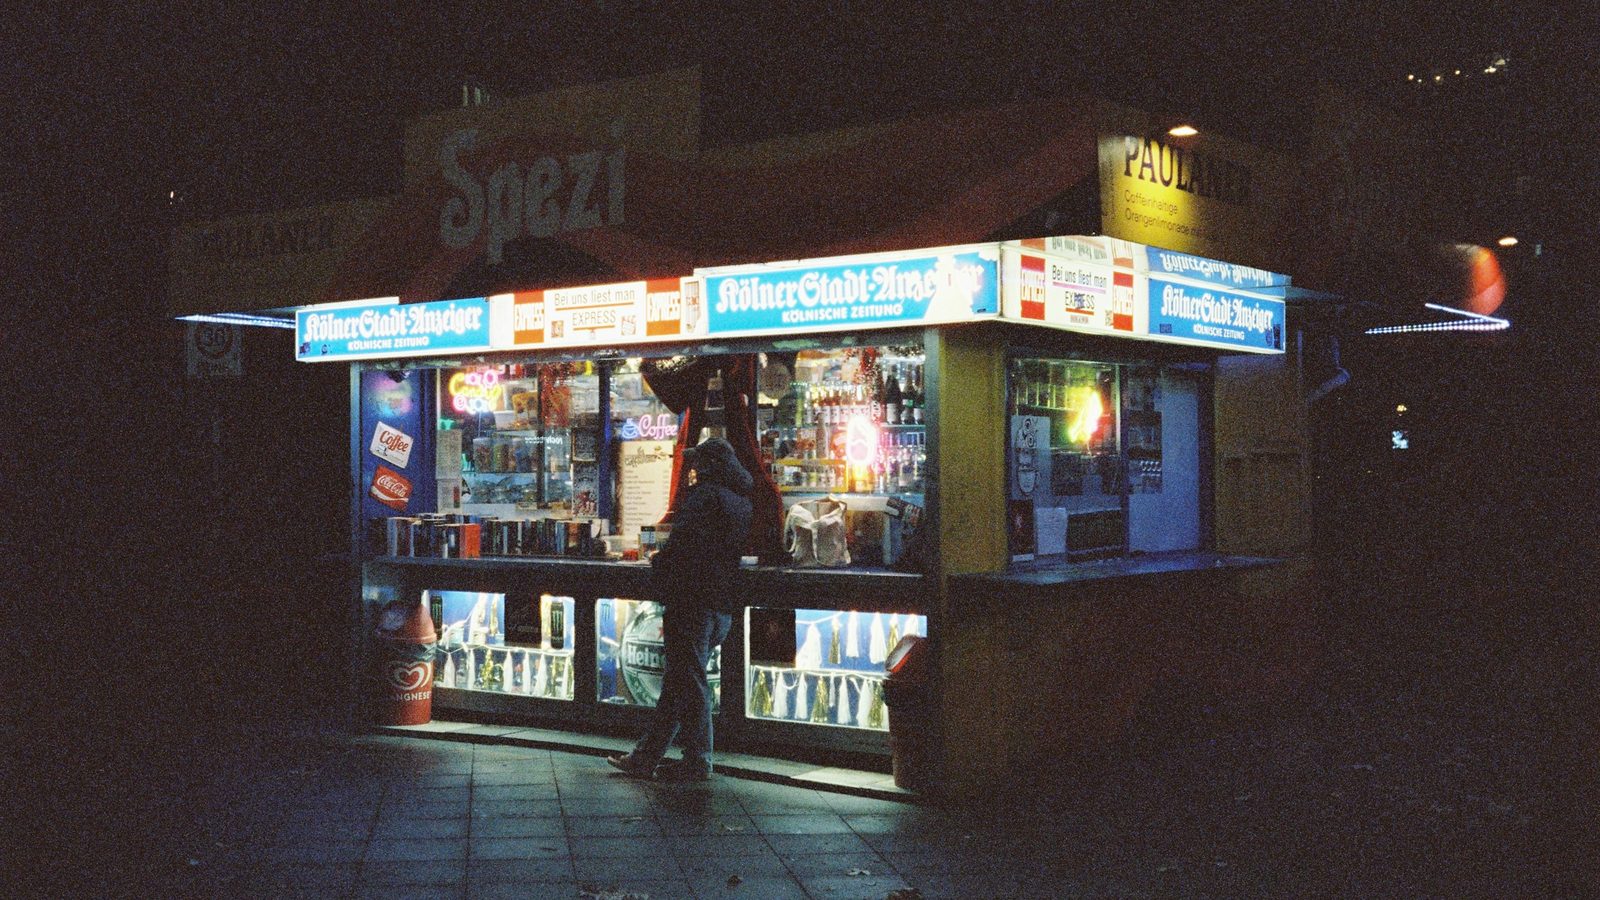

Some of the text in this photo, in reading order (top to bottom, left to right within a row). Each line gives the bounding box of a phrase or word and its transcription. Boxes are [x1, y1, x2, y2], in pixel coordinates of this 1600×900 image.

[439, 118, 627, 265] Spezi
[1052, 264, 1107, 288] Bei uns liest man
[554, 289, 635, 306] Bei uns liest man
[572, 309, 617, 327] EXPRESS
[782, 302, 905, 324] KÖLNISCHE ZEITUNG
[1193, 323, 1245, 341] KÖLNISCHE ZEITUNG
[348, 336, 429, 351] KÖLNISCHE ZEITUNG
[639, 413, 678, 440] Coffee
[379, 430, 409, 452] Coffee
